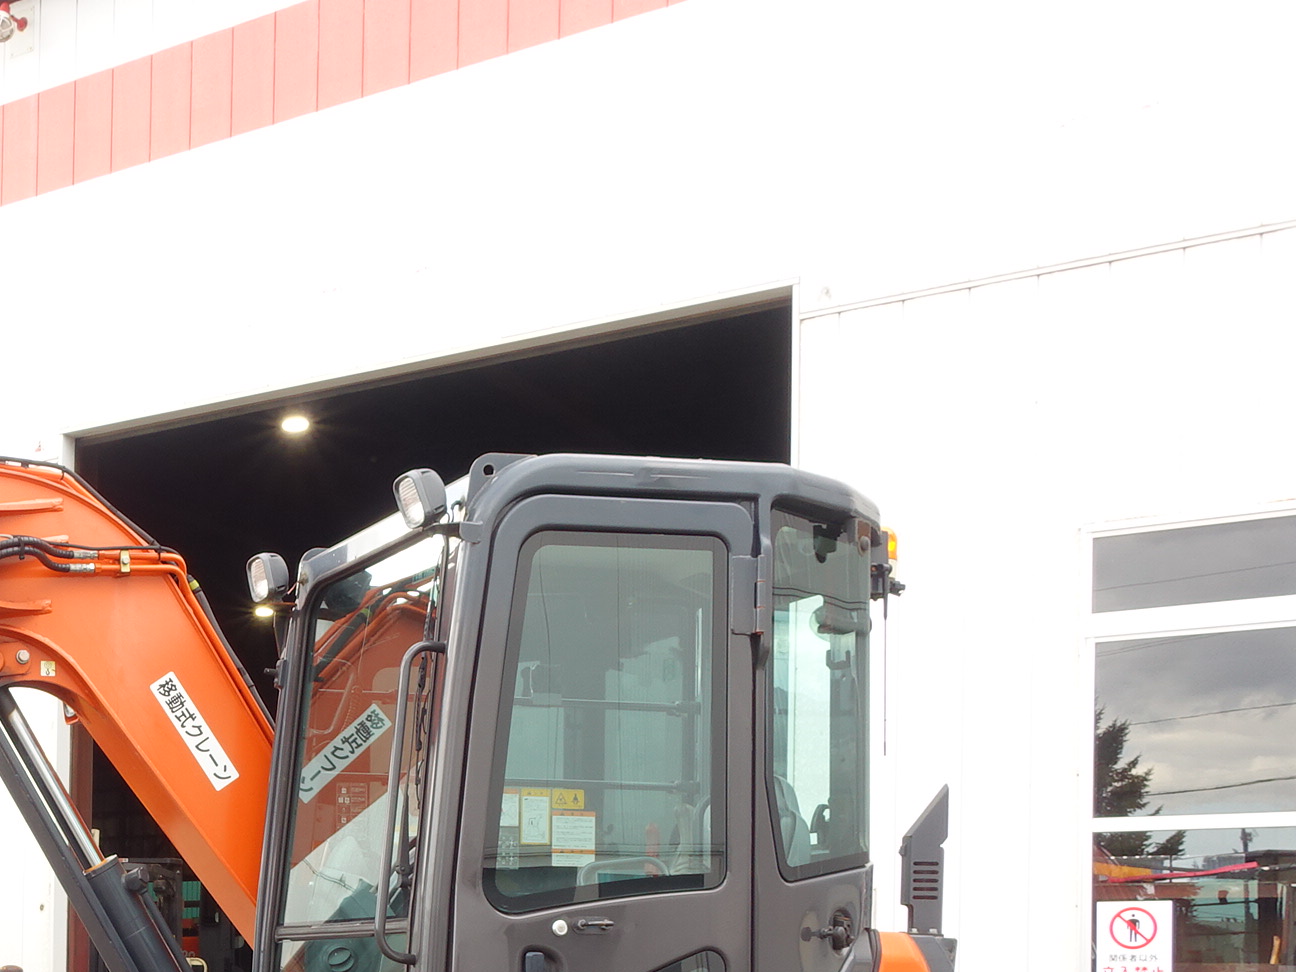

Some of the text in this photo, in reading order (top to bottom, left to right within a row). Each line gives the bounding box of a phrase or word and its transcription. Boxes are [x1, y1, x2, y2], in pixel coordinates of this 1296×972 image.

[157, 677, 232, 780] 移動式クレーン
